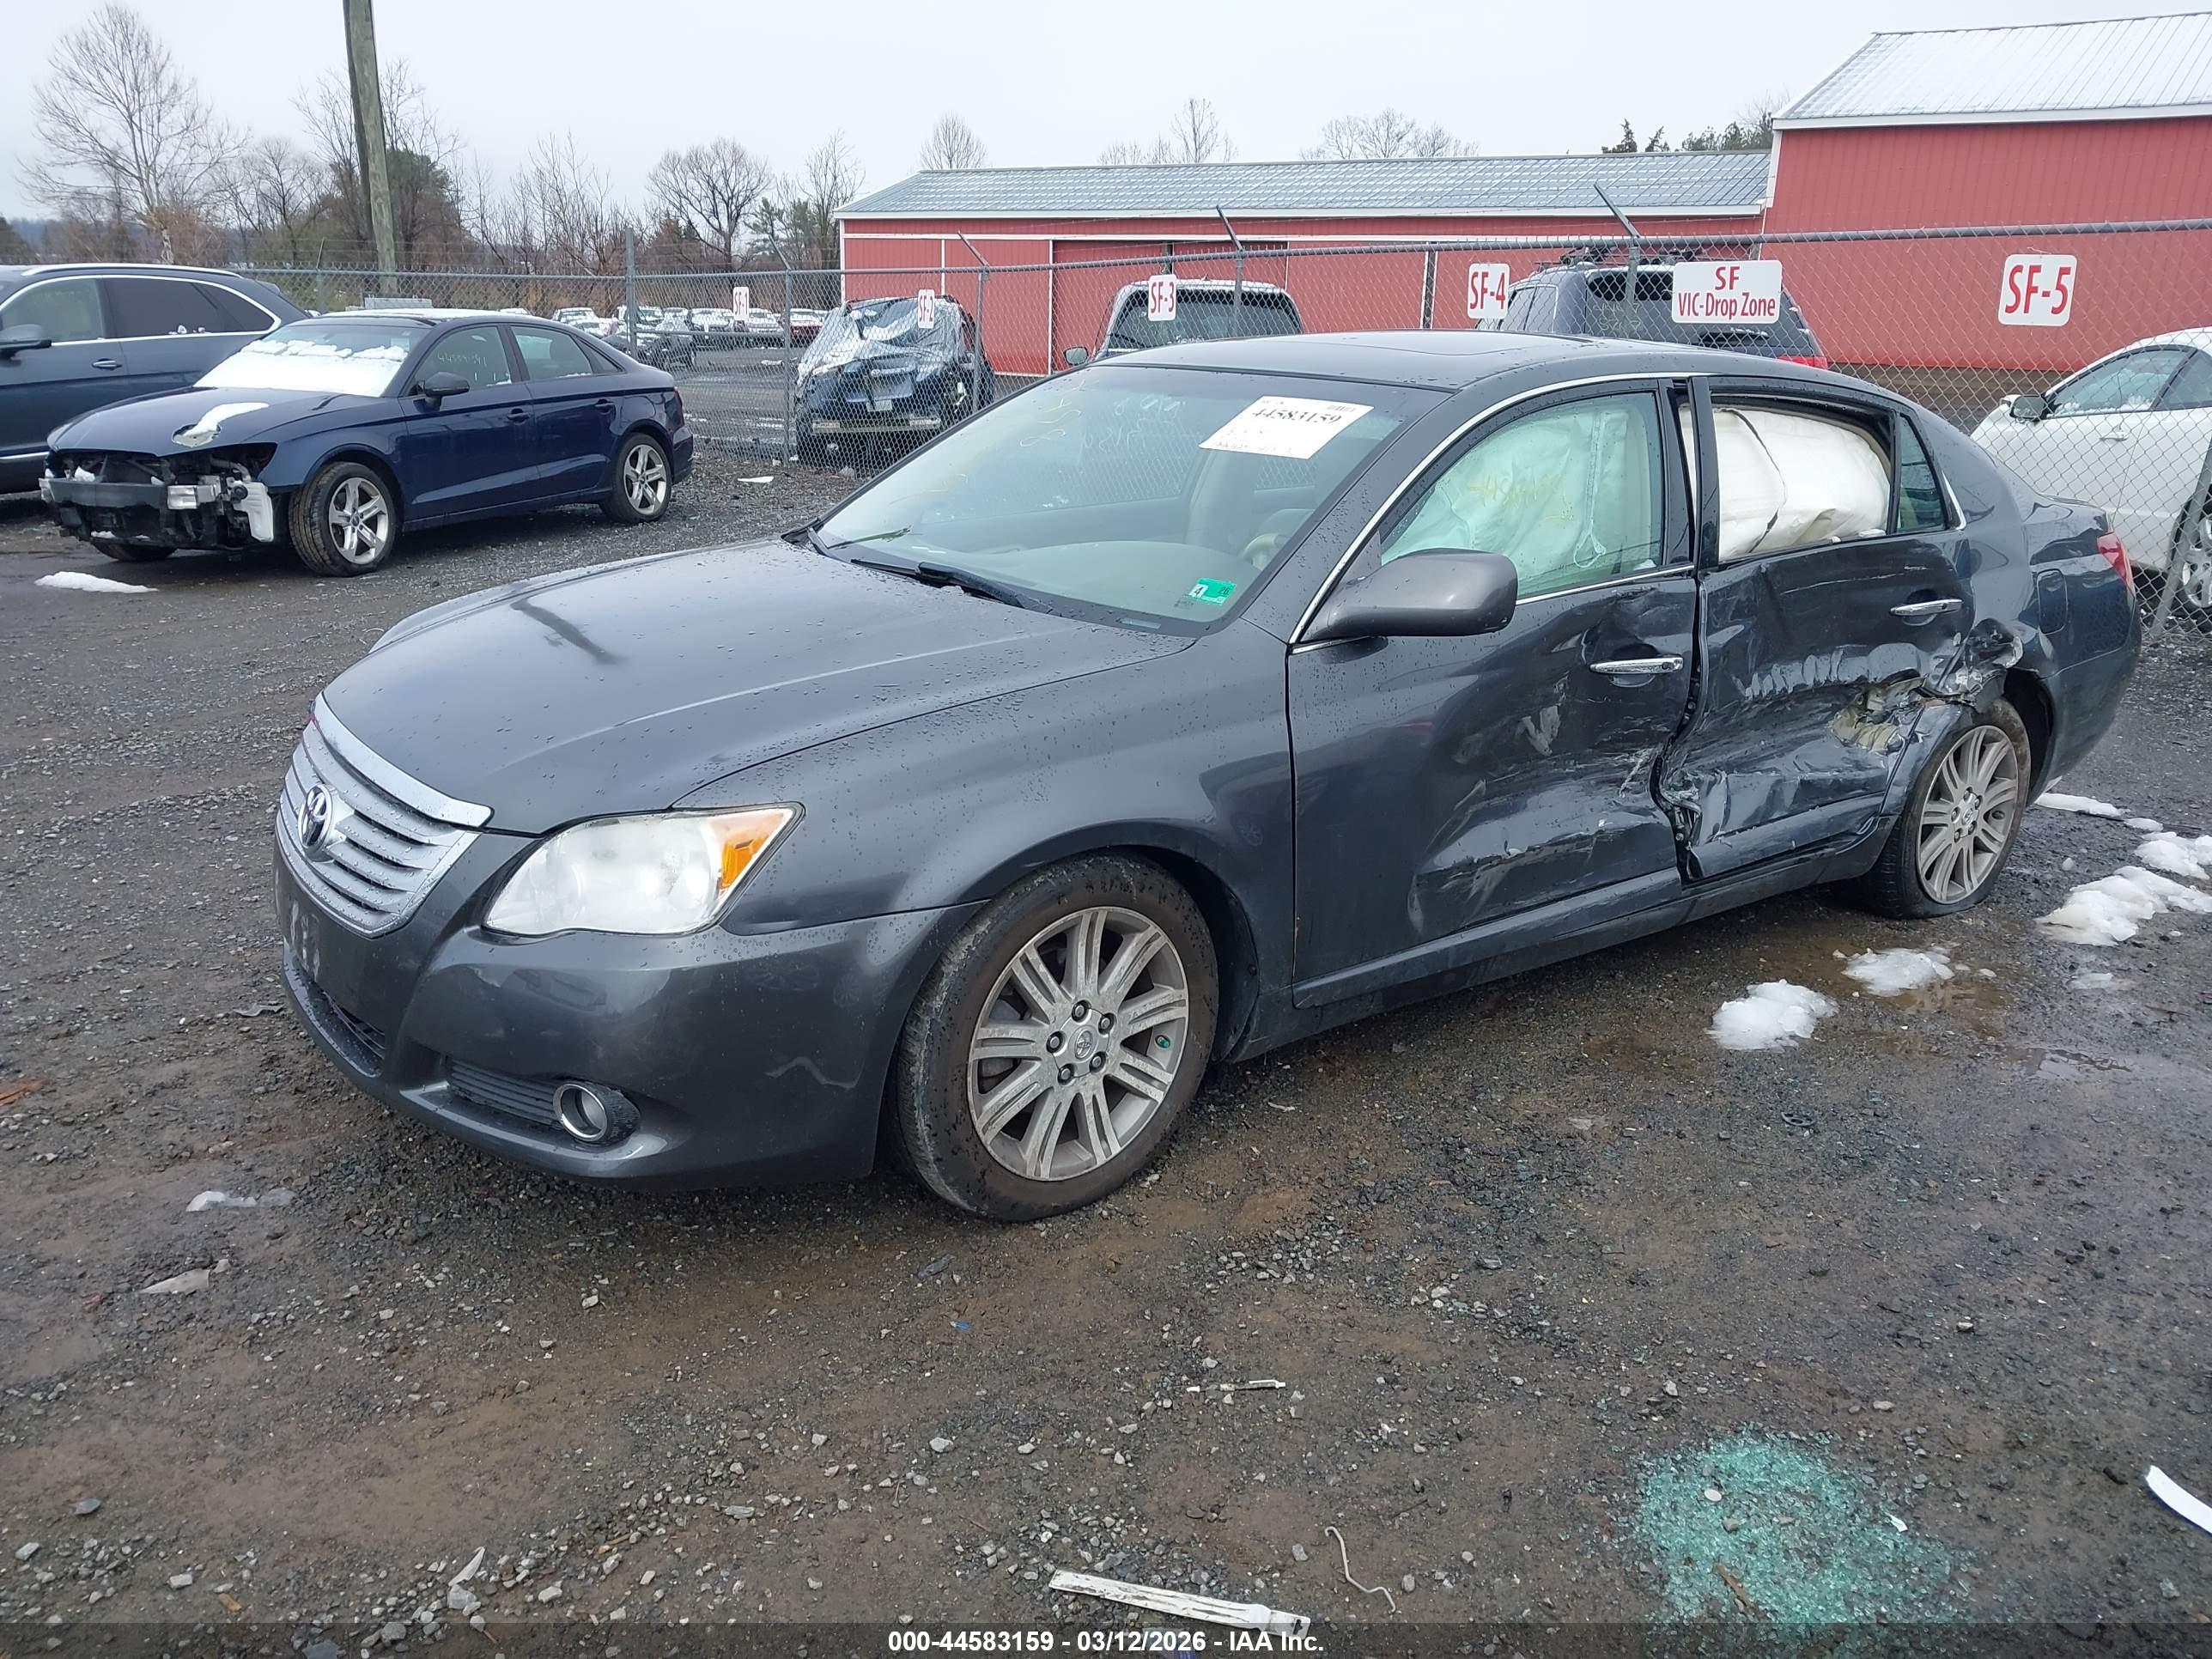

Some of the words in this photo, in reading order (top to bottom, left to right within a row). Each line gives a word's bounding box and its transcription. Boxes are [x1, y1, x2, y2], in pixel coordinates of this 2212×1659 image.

[1469, 271, 1506, 309] SF-4
[1715, 266, 1740, 290] SF
[2005, 264, 2071, 314] SF-5
[734, 292, 748, 315] SF-1
[919, 295, 933, 322] SF-2
[1151, 281, 1175, 313] SF-3
[1678, 292, 1738, 320] VIC-Drop
[1741, 291, 1776, 316] Zone
[1252, 408, 1342, 423] 44583159
[1193, 586, 1204, 596] 4
